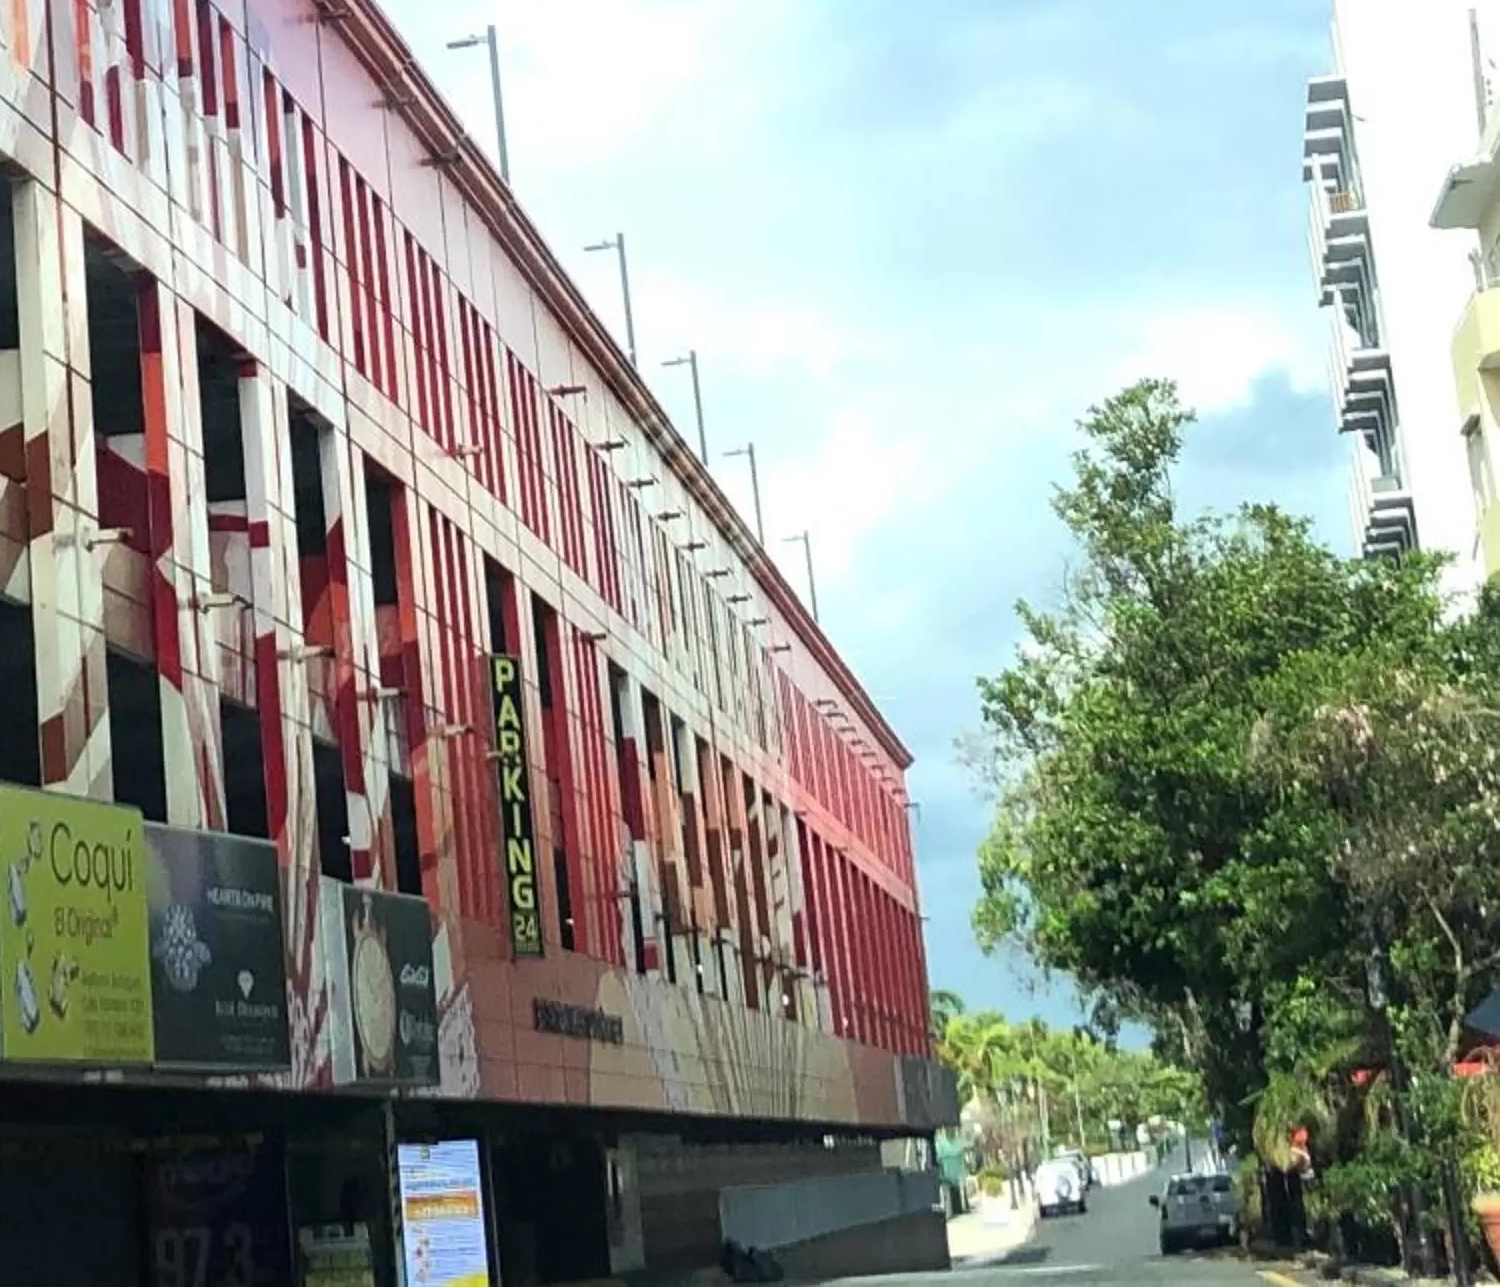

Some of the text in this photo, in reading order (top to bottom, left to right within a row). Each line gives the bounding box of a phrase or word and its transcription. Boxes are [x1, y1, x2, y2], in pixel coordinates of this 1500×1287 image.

[495, 658, 535, 910] PARKING
[50, 821, 134, 904] Coquí
[514, 913, 538, 941] 24
